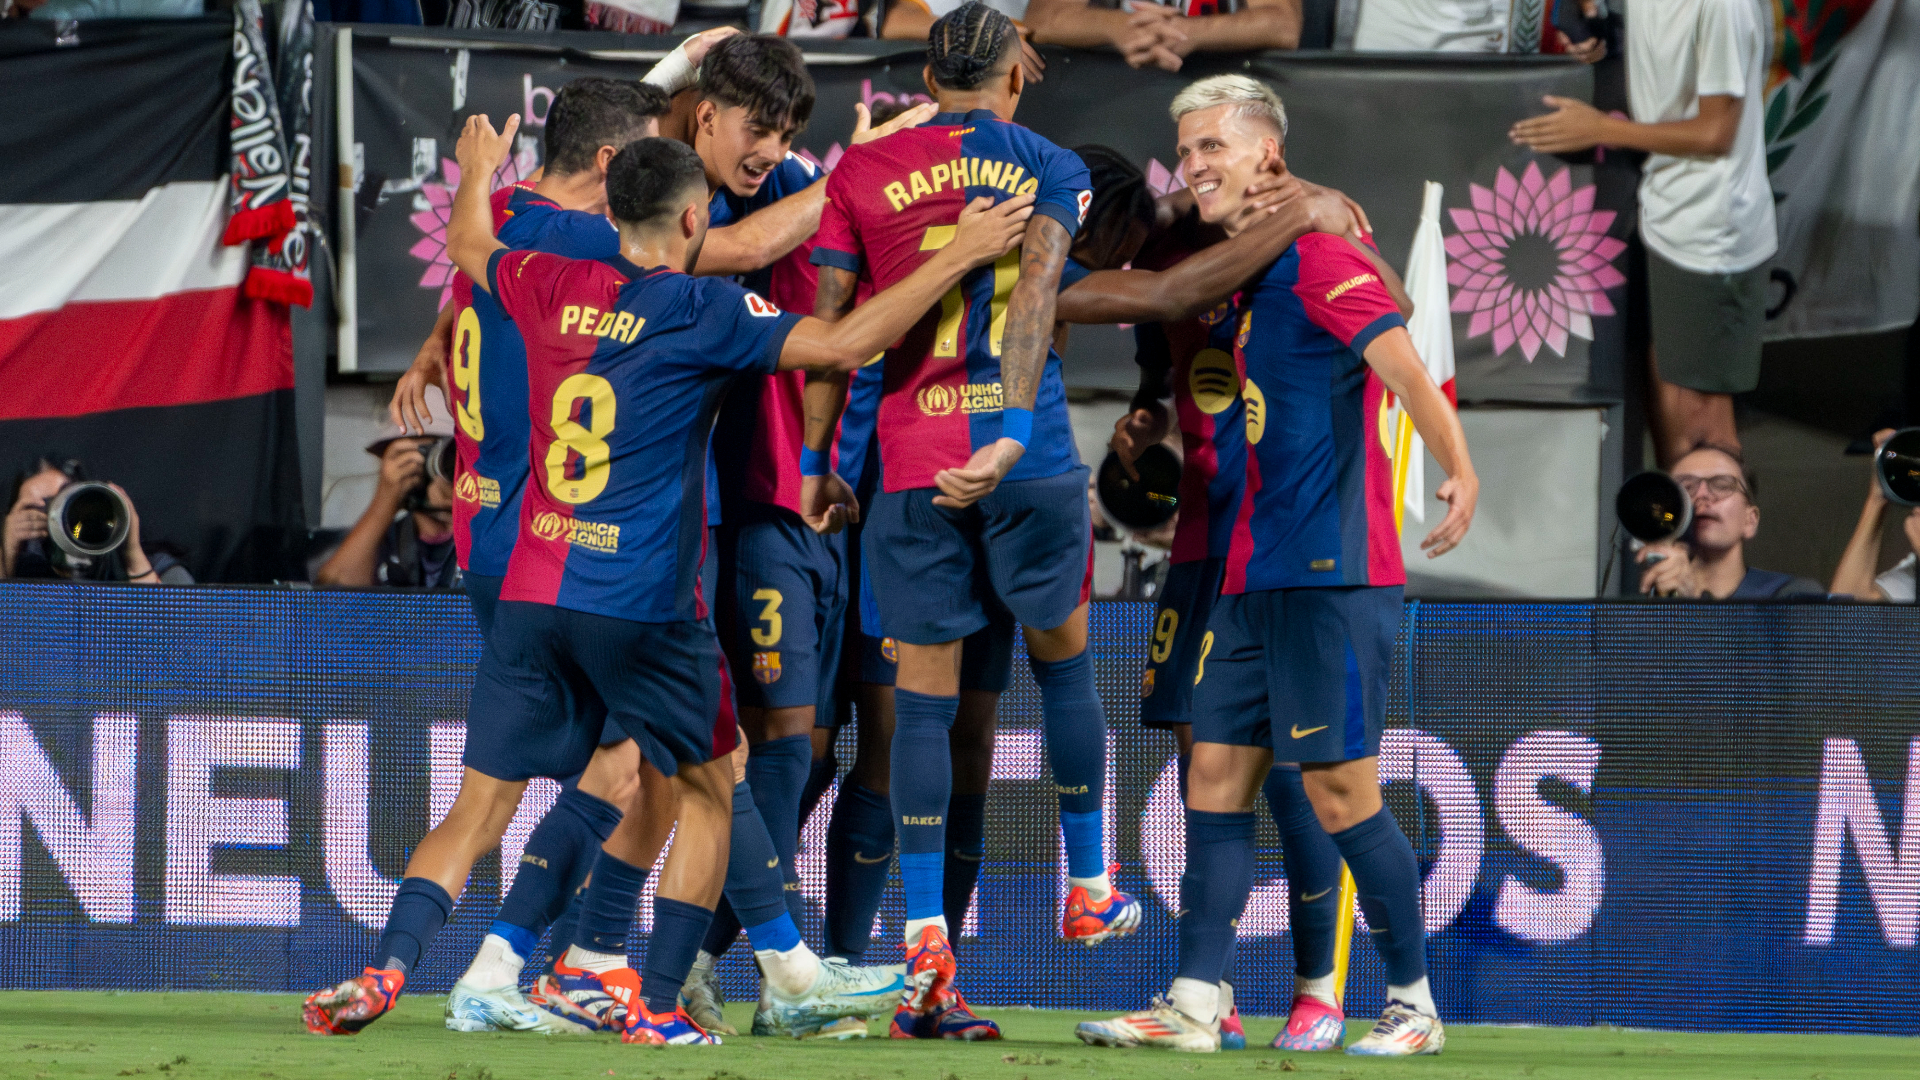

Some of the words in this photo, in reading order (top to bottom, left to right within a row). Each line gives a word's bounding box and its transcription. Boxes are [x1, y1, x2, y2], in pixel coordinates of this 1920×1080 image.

[884, 157, 1039, 212] RAPHINHA
[1326, 273, 1371, 303] AMBILIGHT
[561, 305, 646, 344] PEDRI
[453, 306, 484, 442] 9
[960, 383, 1003, 397] UNHC
[960, 395, 1004, 409] ACNU
[545, 373, 616, 504] 8
[565, 530, 619, 549] ACNUR
[751, 588, 783, 647] 3
[1152, 608, 1179, 663] 9
